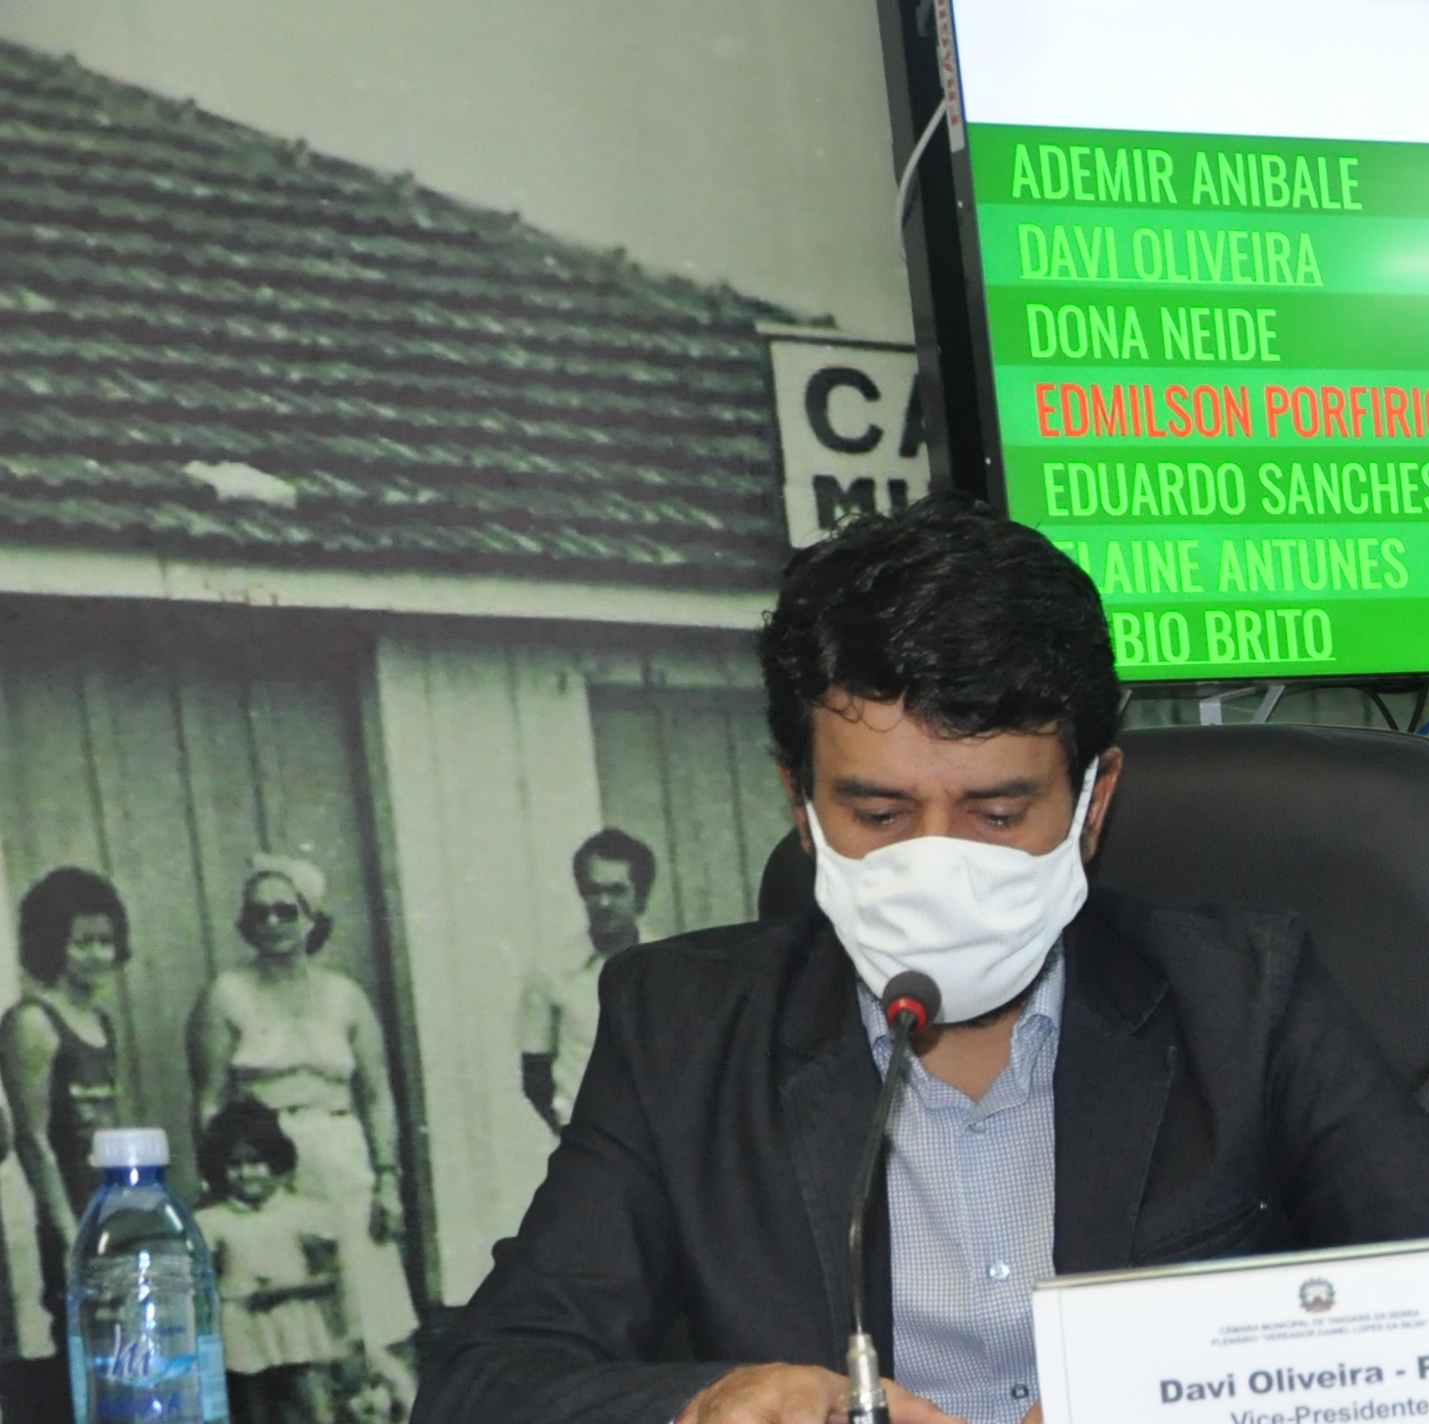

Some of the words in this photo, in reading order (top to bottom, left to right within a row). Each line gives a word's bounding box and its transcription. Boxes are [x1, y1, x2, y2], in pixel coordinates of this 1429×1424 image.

[1012, 144, 1177, 204] ADEMIR
[1192, 151, 1363, 210] ANIBALE
[1018, 223, 1119, 280] DAVI
[1132, 228, 1324, 287] OLIVEIRA
[1026, 304, 1149, 361] DONA
[1160, 306, 1281, 362] NEIDE
[1035, 382, 1252, 438] EDMILSON
[1043, 461, 1246, 517] EDUARDO
[1218, 537, 1410, 592] ANTUNES
[1205, 607, 1334, 663] BRITO
[1159, 1374, 1236, 1404] Davi
[1248, 1362, 1385, 1397] Oliveira
